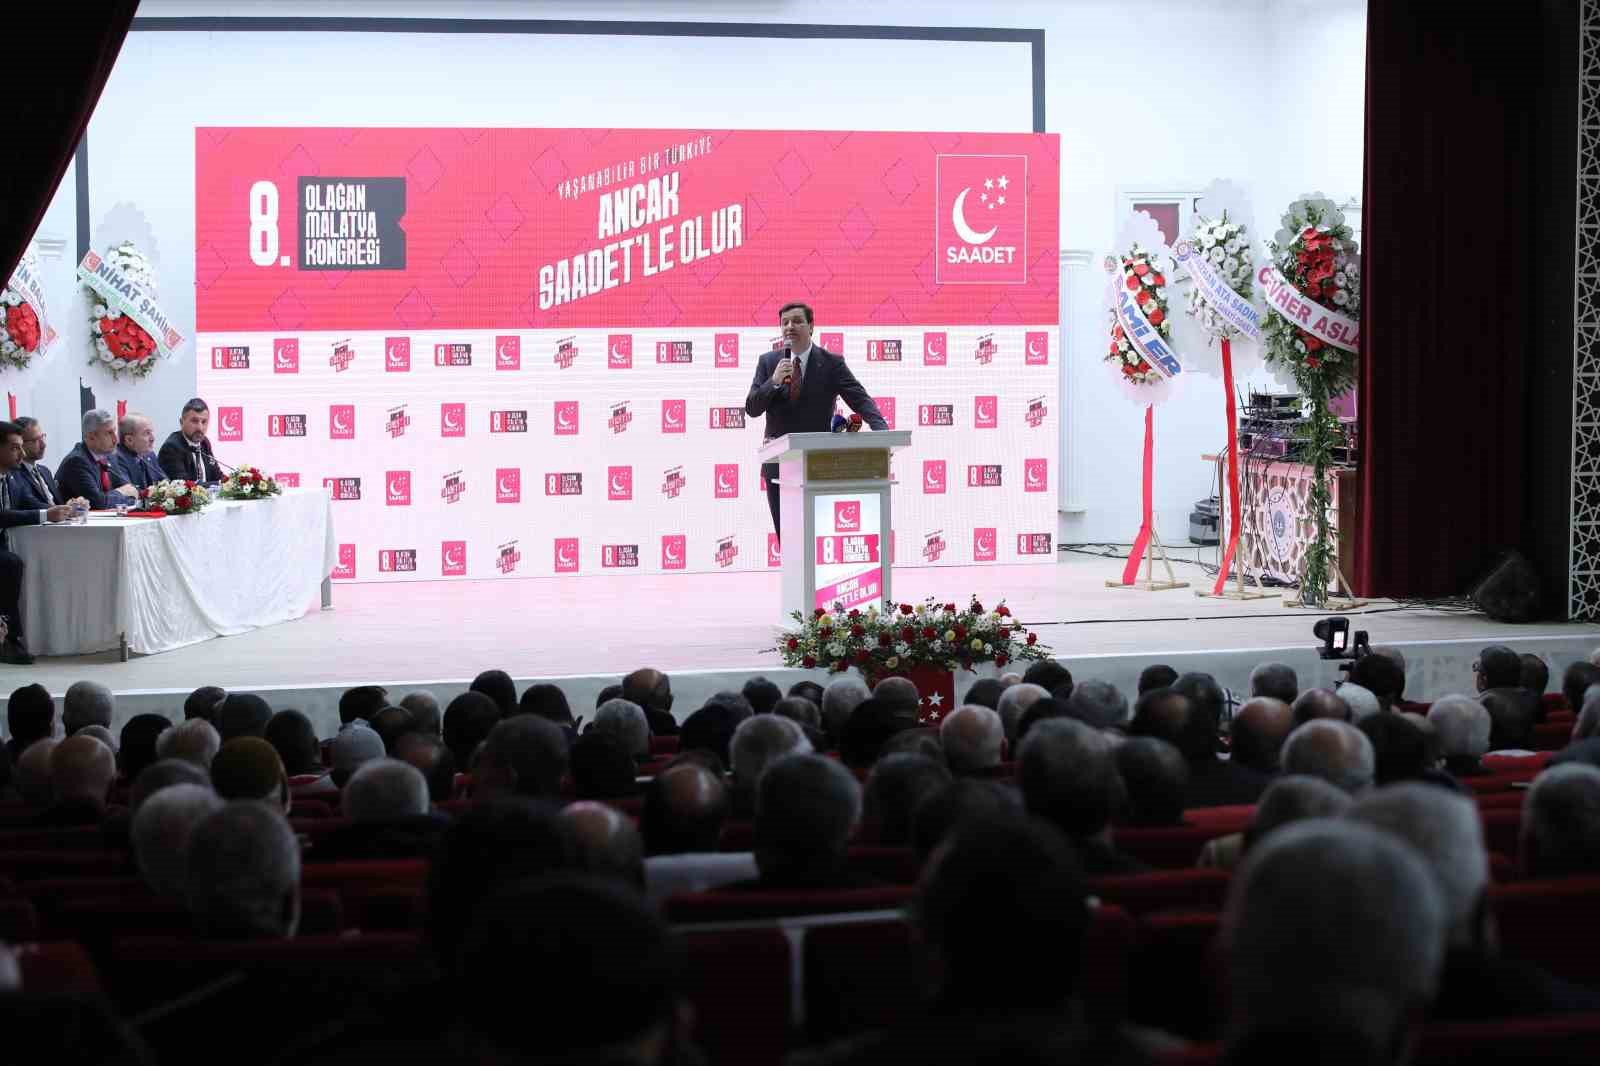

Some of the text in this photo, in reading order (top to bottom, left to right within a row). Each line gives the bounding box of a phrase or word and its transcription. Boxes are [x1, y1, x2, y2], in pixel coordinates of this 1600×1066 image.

[305, 182, 366, 211] OLAĞAN
[598, 171, 680, 240] ANCAK
[250, 181, 291, 266] 8.
[305, 211, 377, 238] MALATYA
[305, 239, 380, 265] KONGRESİ
[538, 203, 743, 310] SAADET'LE OLUR
[947, 246, 1016, 264] SAADET
[96, 262, 141, 301] NİHAT
[1259, 267, 1312, 325] CVHER
[1145, 339, 1181, 376] ER
